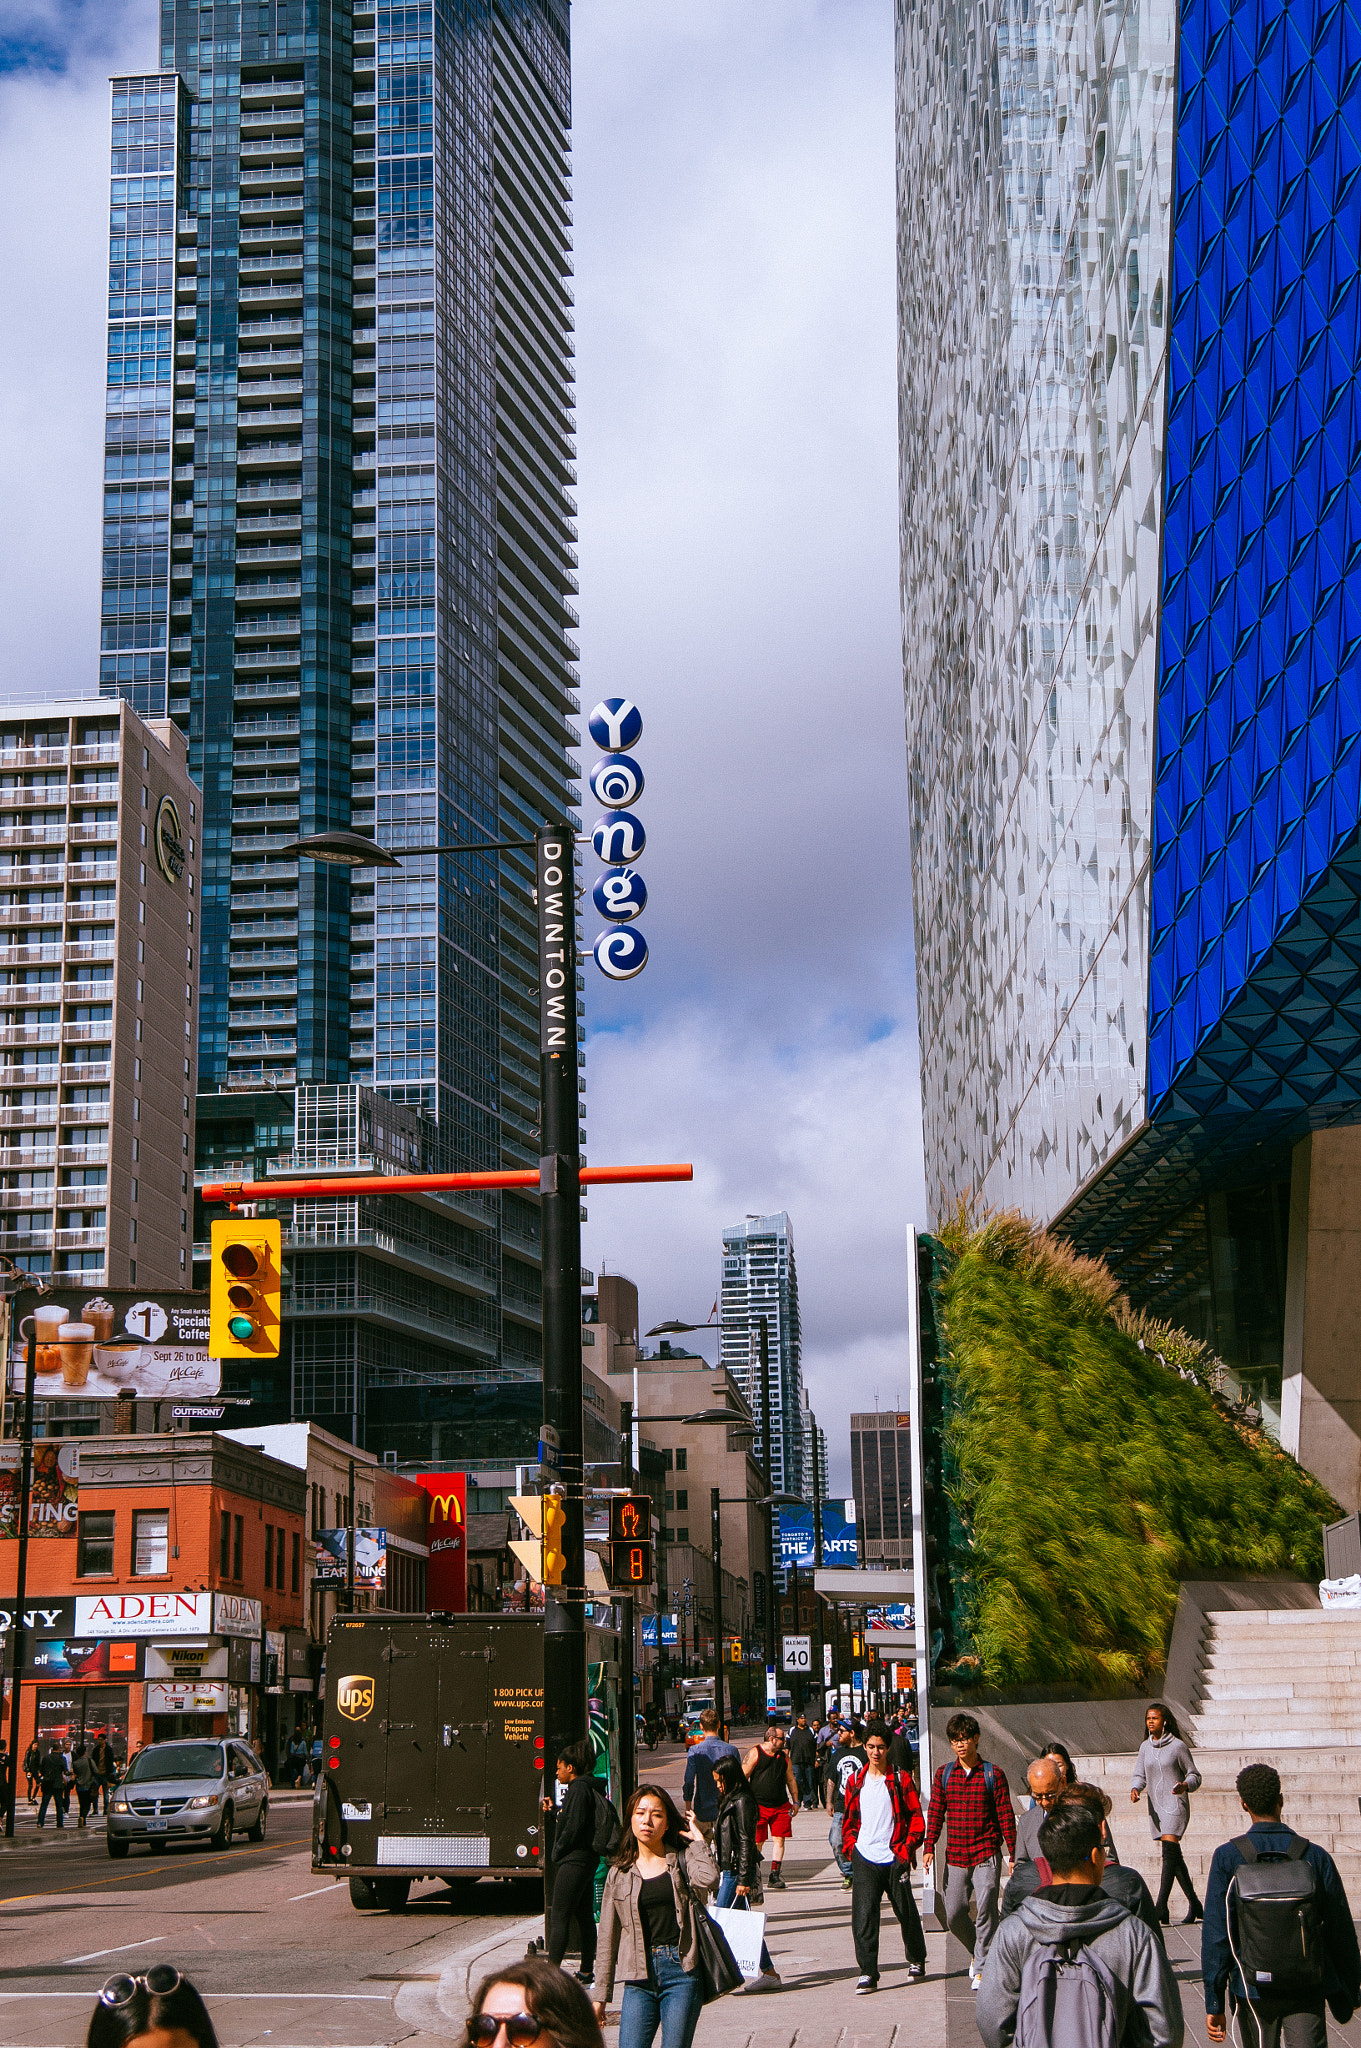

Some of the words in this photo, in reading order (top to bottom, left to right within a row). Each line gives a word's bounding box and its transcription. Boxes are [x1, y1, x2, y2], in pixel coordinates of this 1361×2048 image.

[592, 699, 646, 977] Yonge
[543, 843, 566, 1046] DOWNTOWN
[173, 1316, 210, 1328] Specialt
[154, 1351, 171, 1362] Sept
[174, 1352, 183, 1361] 26
[186, 1352, 193, 1361] to
[196, 1352, 209, 1361] Oct
[174, 1408, 220, 1416] OUTFRONT
[780, 1542, 808, 1554] THE
[822, 1540, 857, 1552] ARTS
[630, 1548, 643, 1580] 8
[315, 1566, 387, 1578] LEARNING
[88, 1594, 200, 1620] ADEN
[219, 1595, 256, 1622] ADEN
[172, 1650, 204, 1660] Nikon
[786, 1651, 808, 1665] 40
[151, 1683, 224, 1692] ADEN
[499, 1688, 514, 1697] 800
[515, 1688, 533, 1697] PICK
[39, 1700, 74, 1709] SONY
[340, 1689, 371, 1714] ups
[504, 1725, 532, 1733] Propane
[504, 1733, 529, 1741] Vehicle
